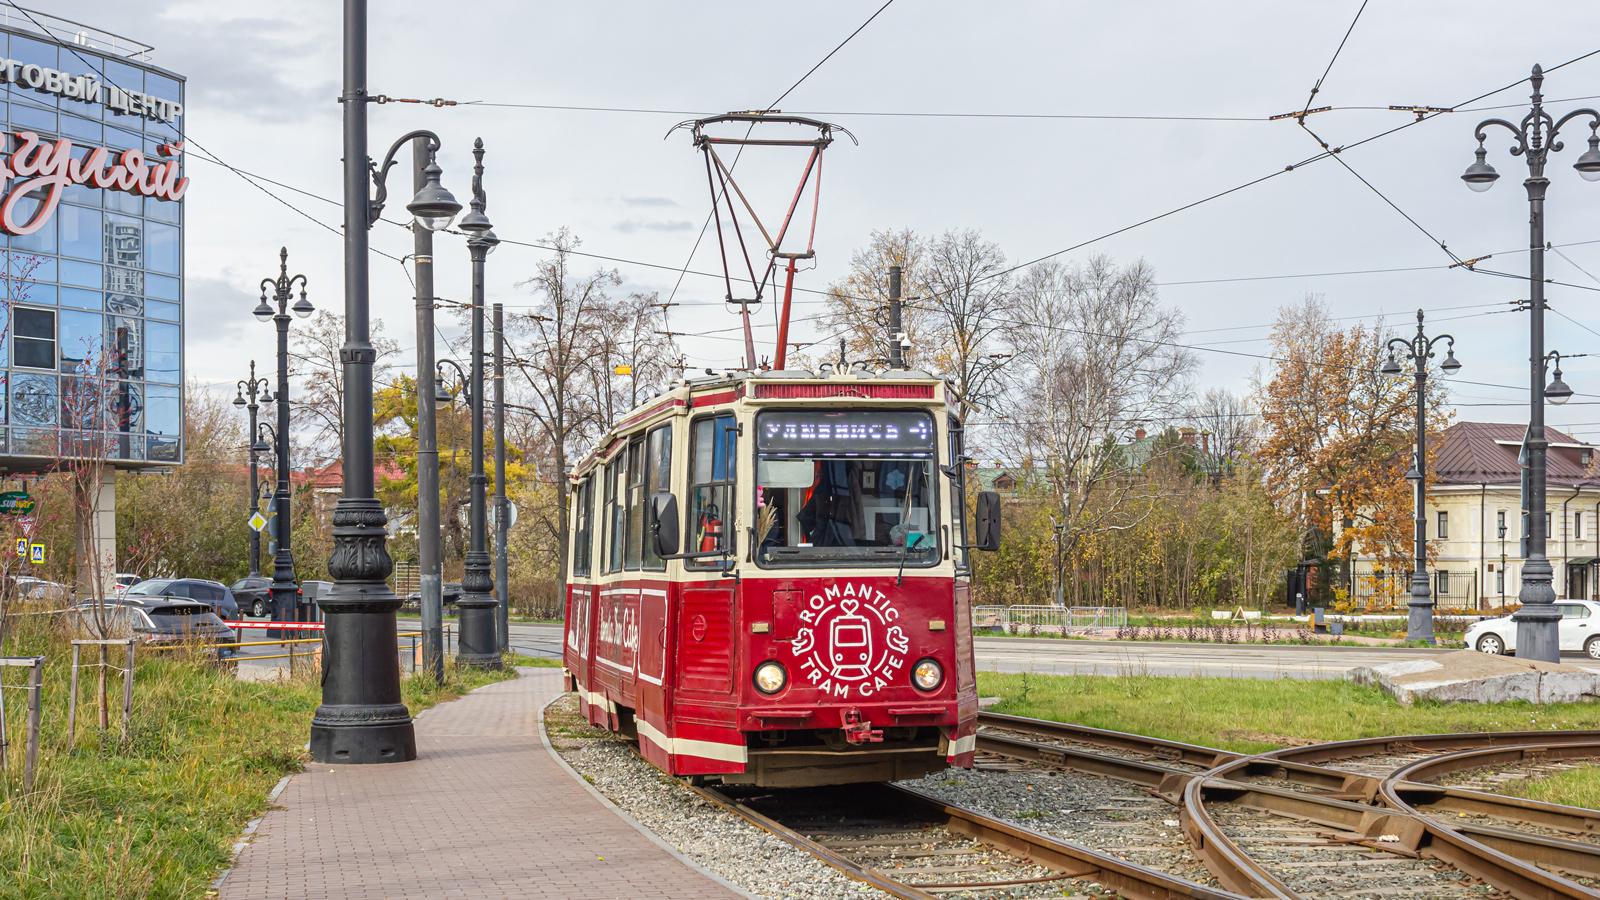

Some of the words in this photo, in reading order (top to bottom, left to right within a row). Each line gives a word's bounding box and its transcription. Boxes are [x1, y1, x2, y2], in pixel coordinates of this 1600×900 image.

[110, 86, 184, 123] ЦЕНТР
[0, 499, 34, 508] SUBWAY
[800, 582, 899, 623] ROMANTIC
[800, 656, 849, 699] TRAM
[859, 655, 903, 696] CAFE
